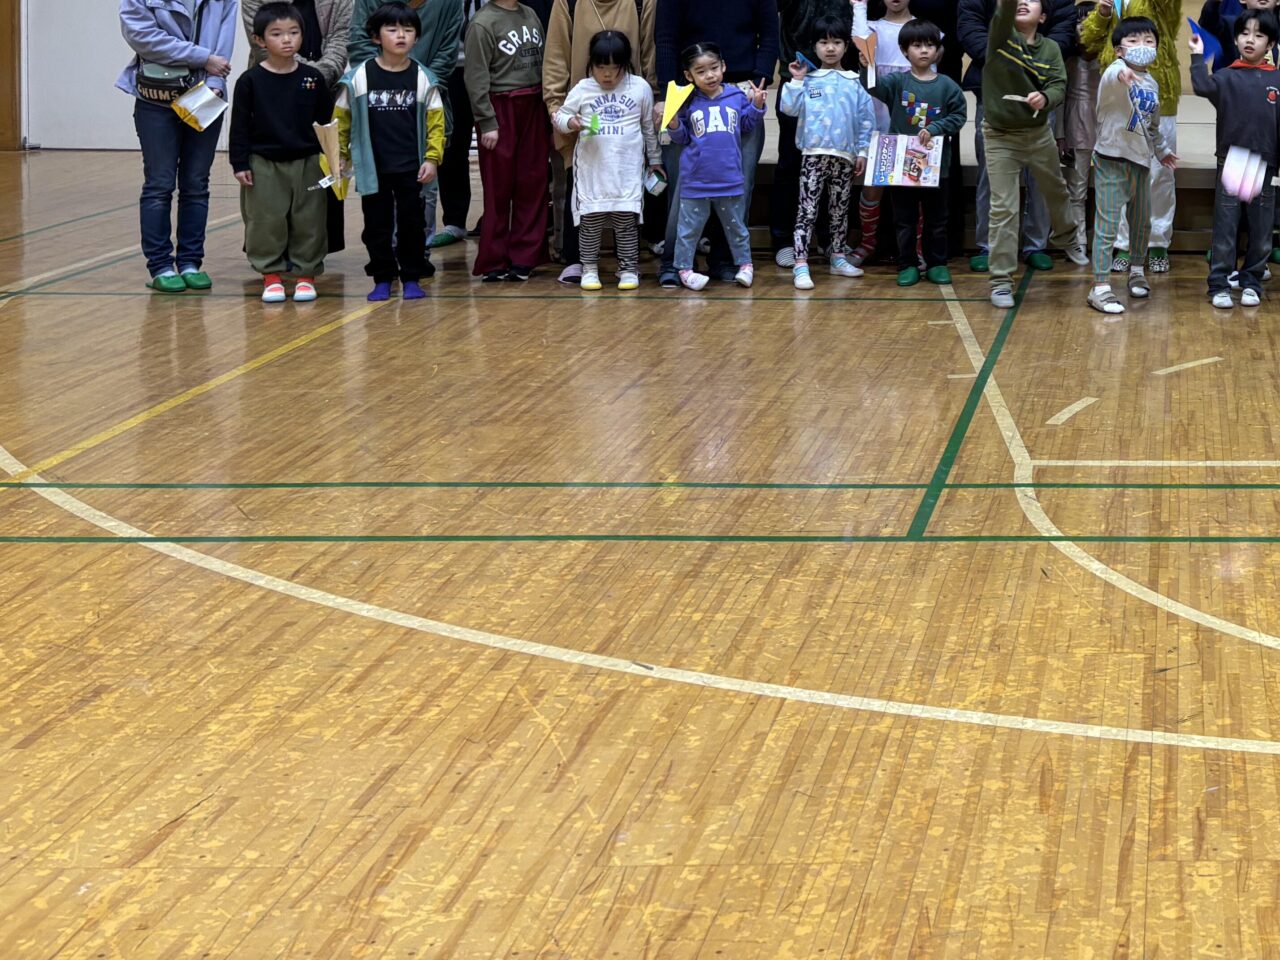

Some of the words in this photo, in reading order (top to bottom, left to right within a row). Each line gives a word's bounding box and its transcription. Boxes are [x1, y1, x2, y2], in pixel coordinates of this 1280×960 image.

[498, 25, 542, 55] GRAS
[590, 93, 617, 112] ANNA
[619, 94, 637, 110] SUI
[598, 125, 624, 135] MINI
[690, 105, 739, 138] GAP
